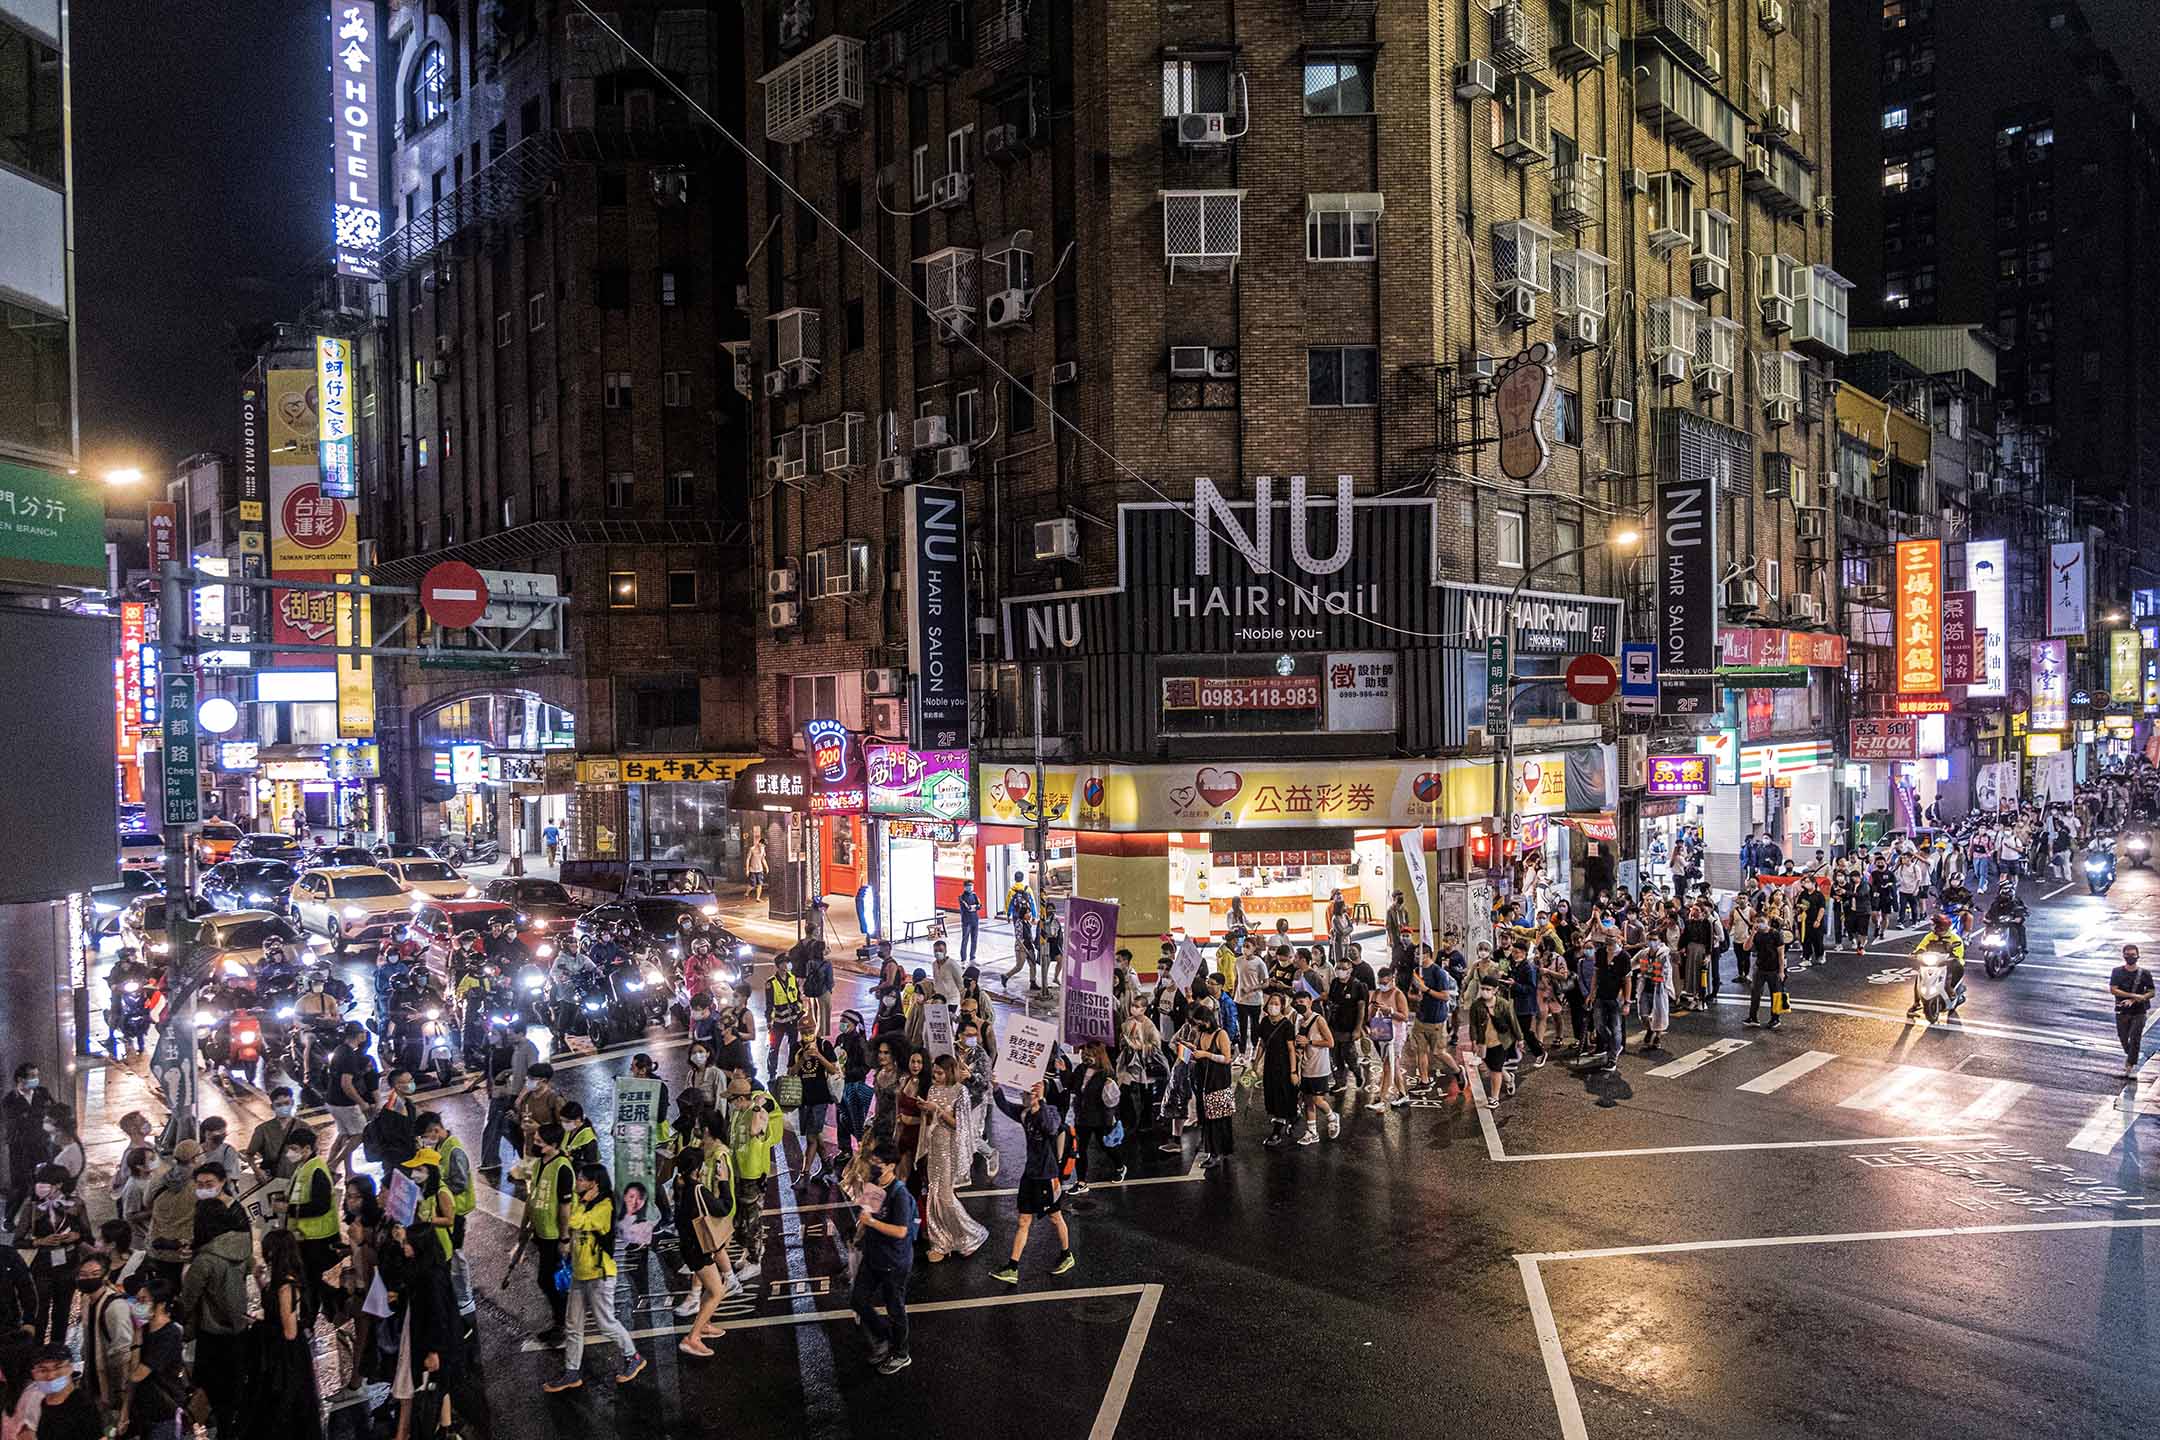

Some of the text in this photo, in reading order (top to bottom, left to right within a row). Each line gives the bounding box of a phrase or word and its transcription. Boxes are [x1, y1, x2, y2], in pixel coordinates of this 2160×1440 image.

[344, 79, 369, 204] HOTEL
[325, 360, 345, 436] 蚵仔之家
[244, 404, 256, 473] COLORMIX
[295, 497, 333, 516] 台灣
[1666, 488, 1703, 548] NU
[16, 524, 58, 537] BRANCH
[294, 517, 336, 537] 運彩
[924, 497, 957, 562] NU
[1195, 475, 1353, 576] NU
[1464, 596, 1503, 641] NU
[1669, 555, 1685, 664] HAIR SALON
[1903, 547, 1934, 671] 三媽臭臭鍋
[928, 570, 944, 692] HAIR SALON
[1027, 602, 1082, 649] NU
[1592, 625, 1606, 643] 2F
[1330, 663, 1357, 690] 徵
[1358, 664, 1394, 676] 設計師
[1491, 648, 1503, 696] 昆明街
[1365, 677, 1389, 688] 助理
[1202, 687, 1318, 707] 0983-118-983
[1677, 698, 1698, 712] 2F
[170, 692, 189, 762] 成都路
[938, 731, 956, 747] 2F
[1854, 736, 1913, 750] 卡拉OK
[820, 748, 840, 768] 200
[934, 753, 968, 764] マッサージ
[167, 767, 194, 777] Cheng
[625, 758, 731, 782] 台北牛乳大王
[869, 751, 928, 795] 西門町
[168, 778, 180, 786] Du
[755, 774, 804, 795] 世運食品
[1541, 771, 1564, 794] 公益
[1255, 783, 1375, 814] 公益彩券
[618, 1103, 651, 1122] 起飛
